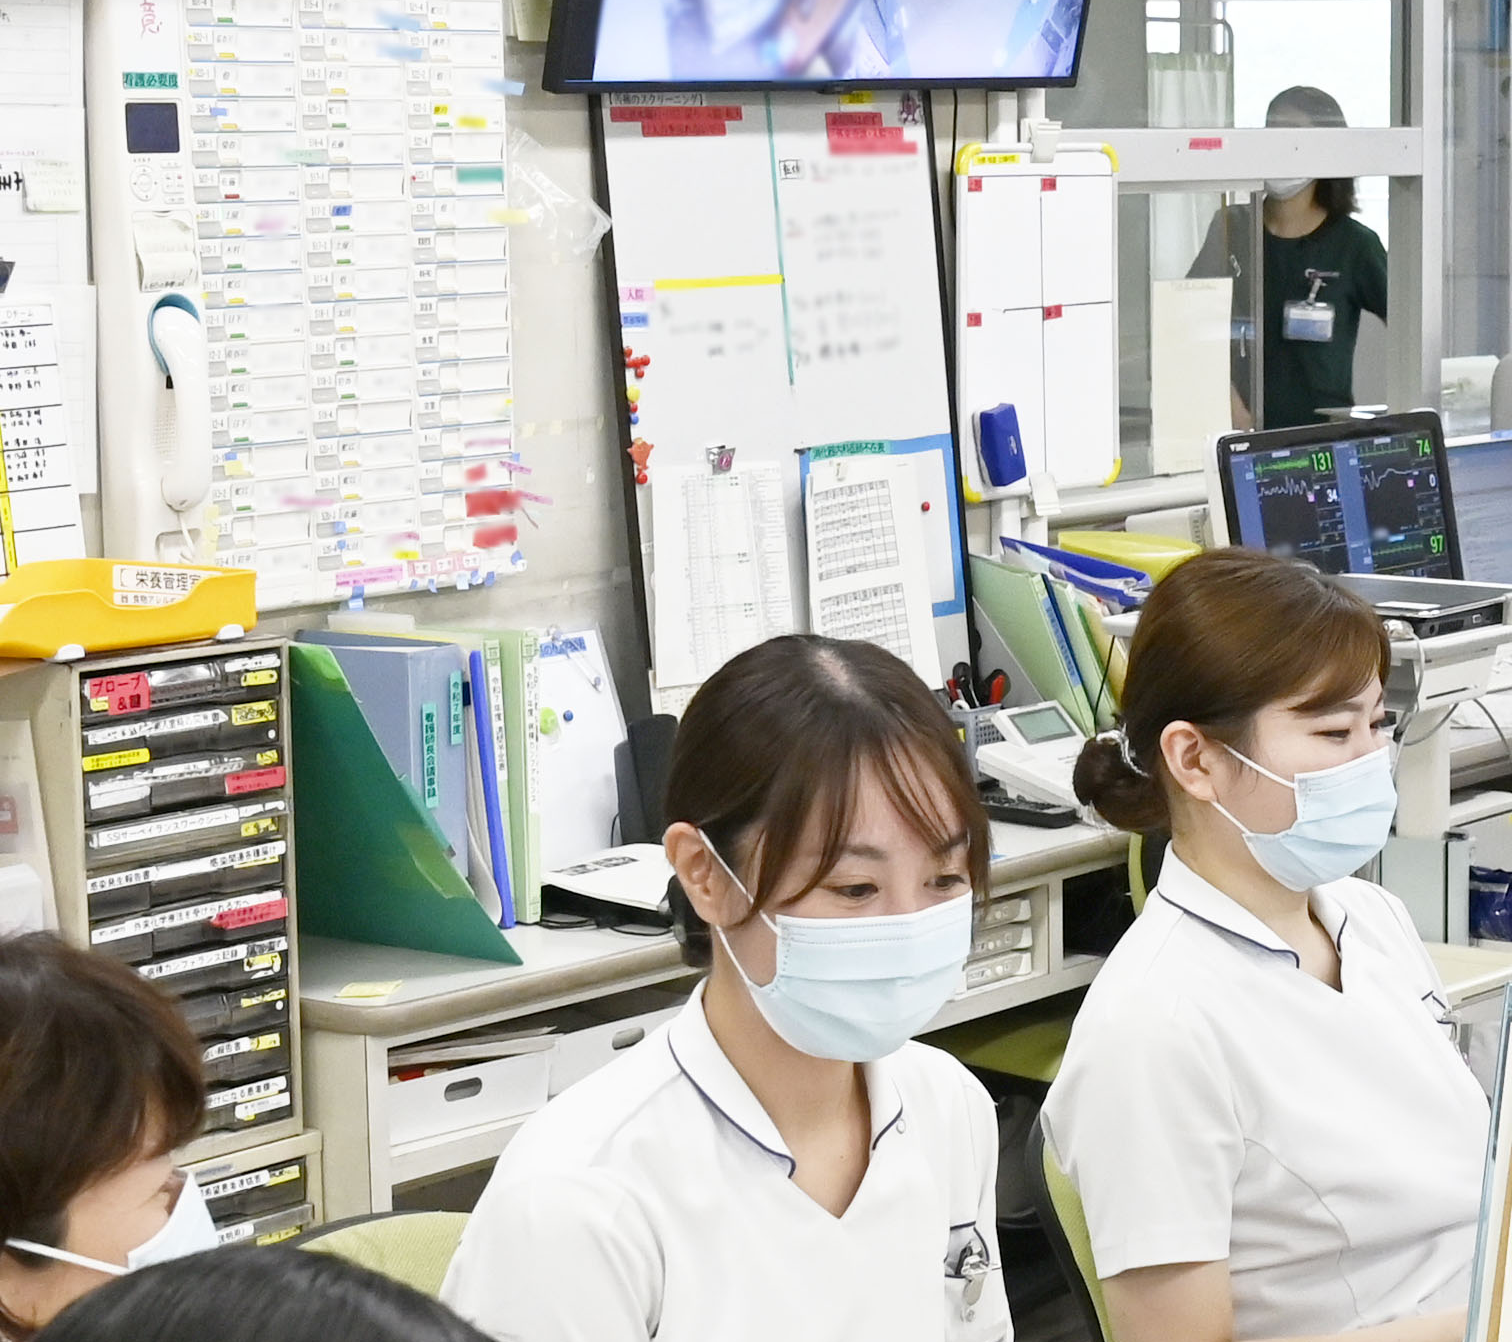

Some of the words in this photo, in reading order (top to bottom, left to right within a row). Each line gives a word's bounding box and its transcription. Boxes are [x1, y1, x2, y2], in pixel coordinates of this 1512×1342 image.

[123, 72, 178, 88] 看護必要度
[626, 288, 645, 301] 入院
[1416, 439, 1432, 457] 74
[1312, 451, 1333, 472] 131
[1429, 474, 1436, 488] 0
[1326, 487, 1338, 504] 34
[1430, 534, 1444, 554] 97
[451, 680, 462, 736] 令和7年度
[424, 711, 437, 799] 看護師長会議事録
[90, 870, 151, 891] 感染発生報告書
